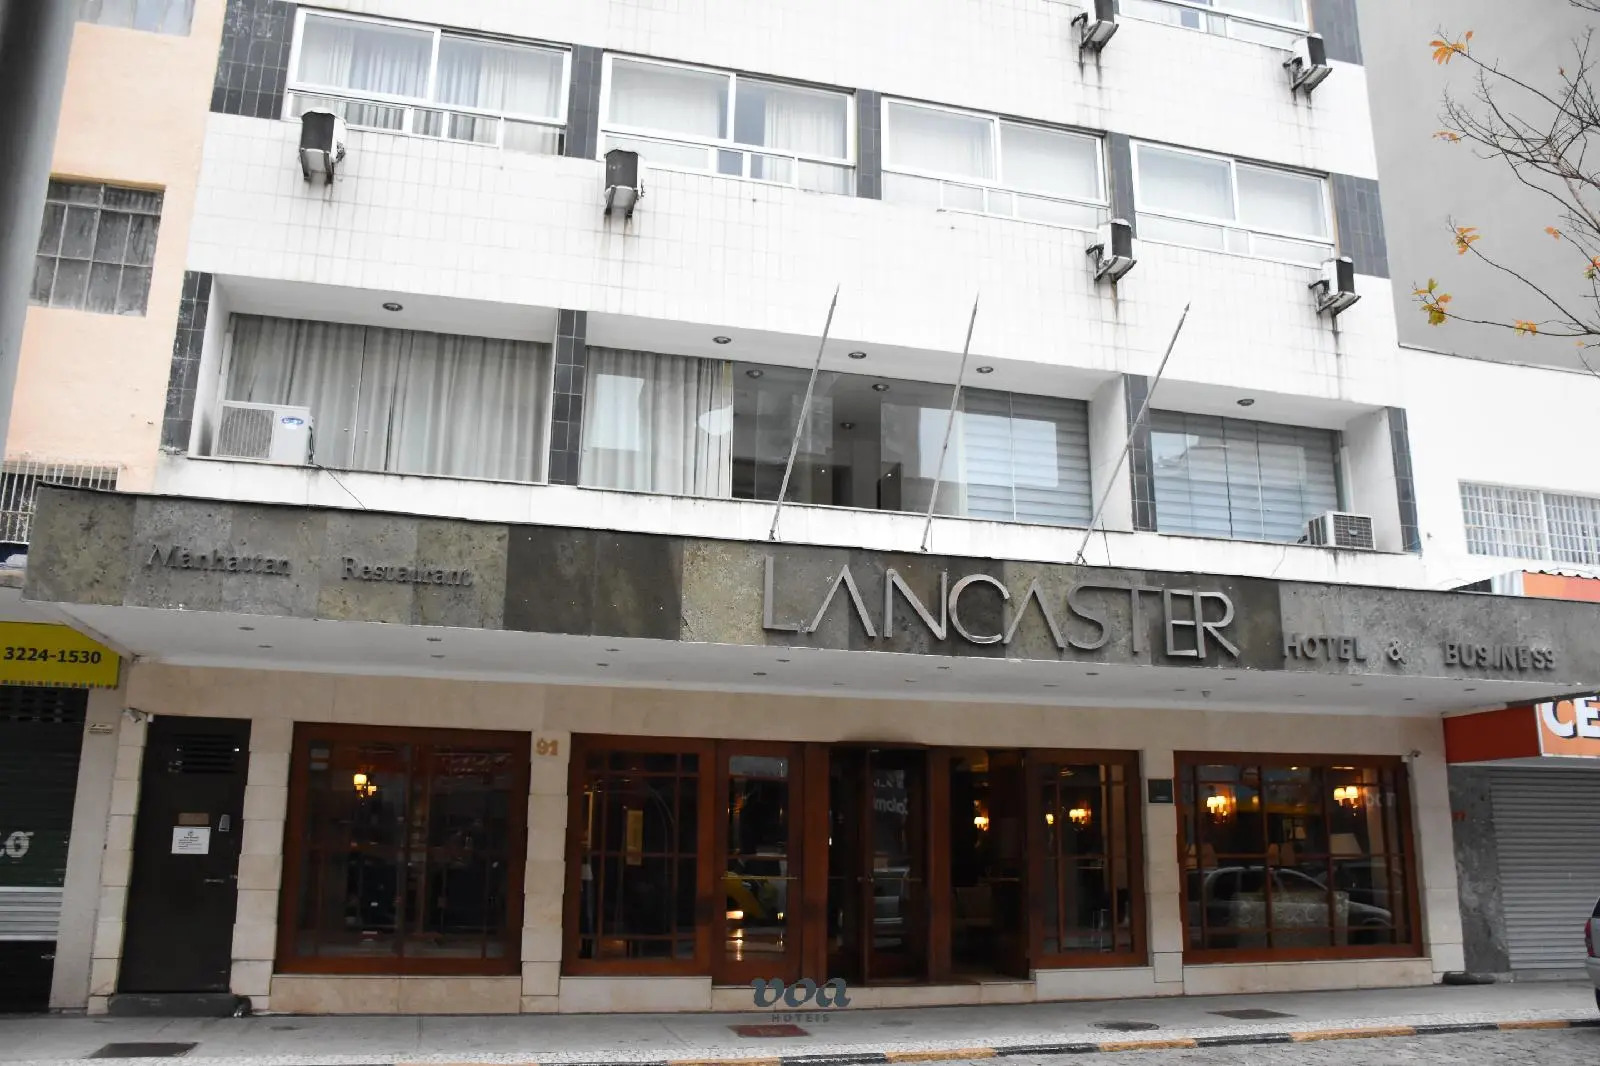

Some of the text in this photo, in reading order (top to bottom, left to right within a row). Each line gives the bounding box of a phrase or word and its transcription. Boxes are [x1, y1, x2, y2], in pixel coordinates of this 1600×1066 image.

[147, 544, 474, 587] Manhattan Restaurant
[761, 555, 1241, 660] LANCASTER
[3, 646, 102, 665] 3224-1530
[1282, 633, 1556, 672] HOTEL & BUSINESS
